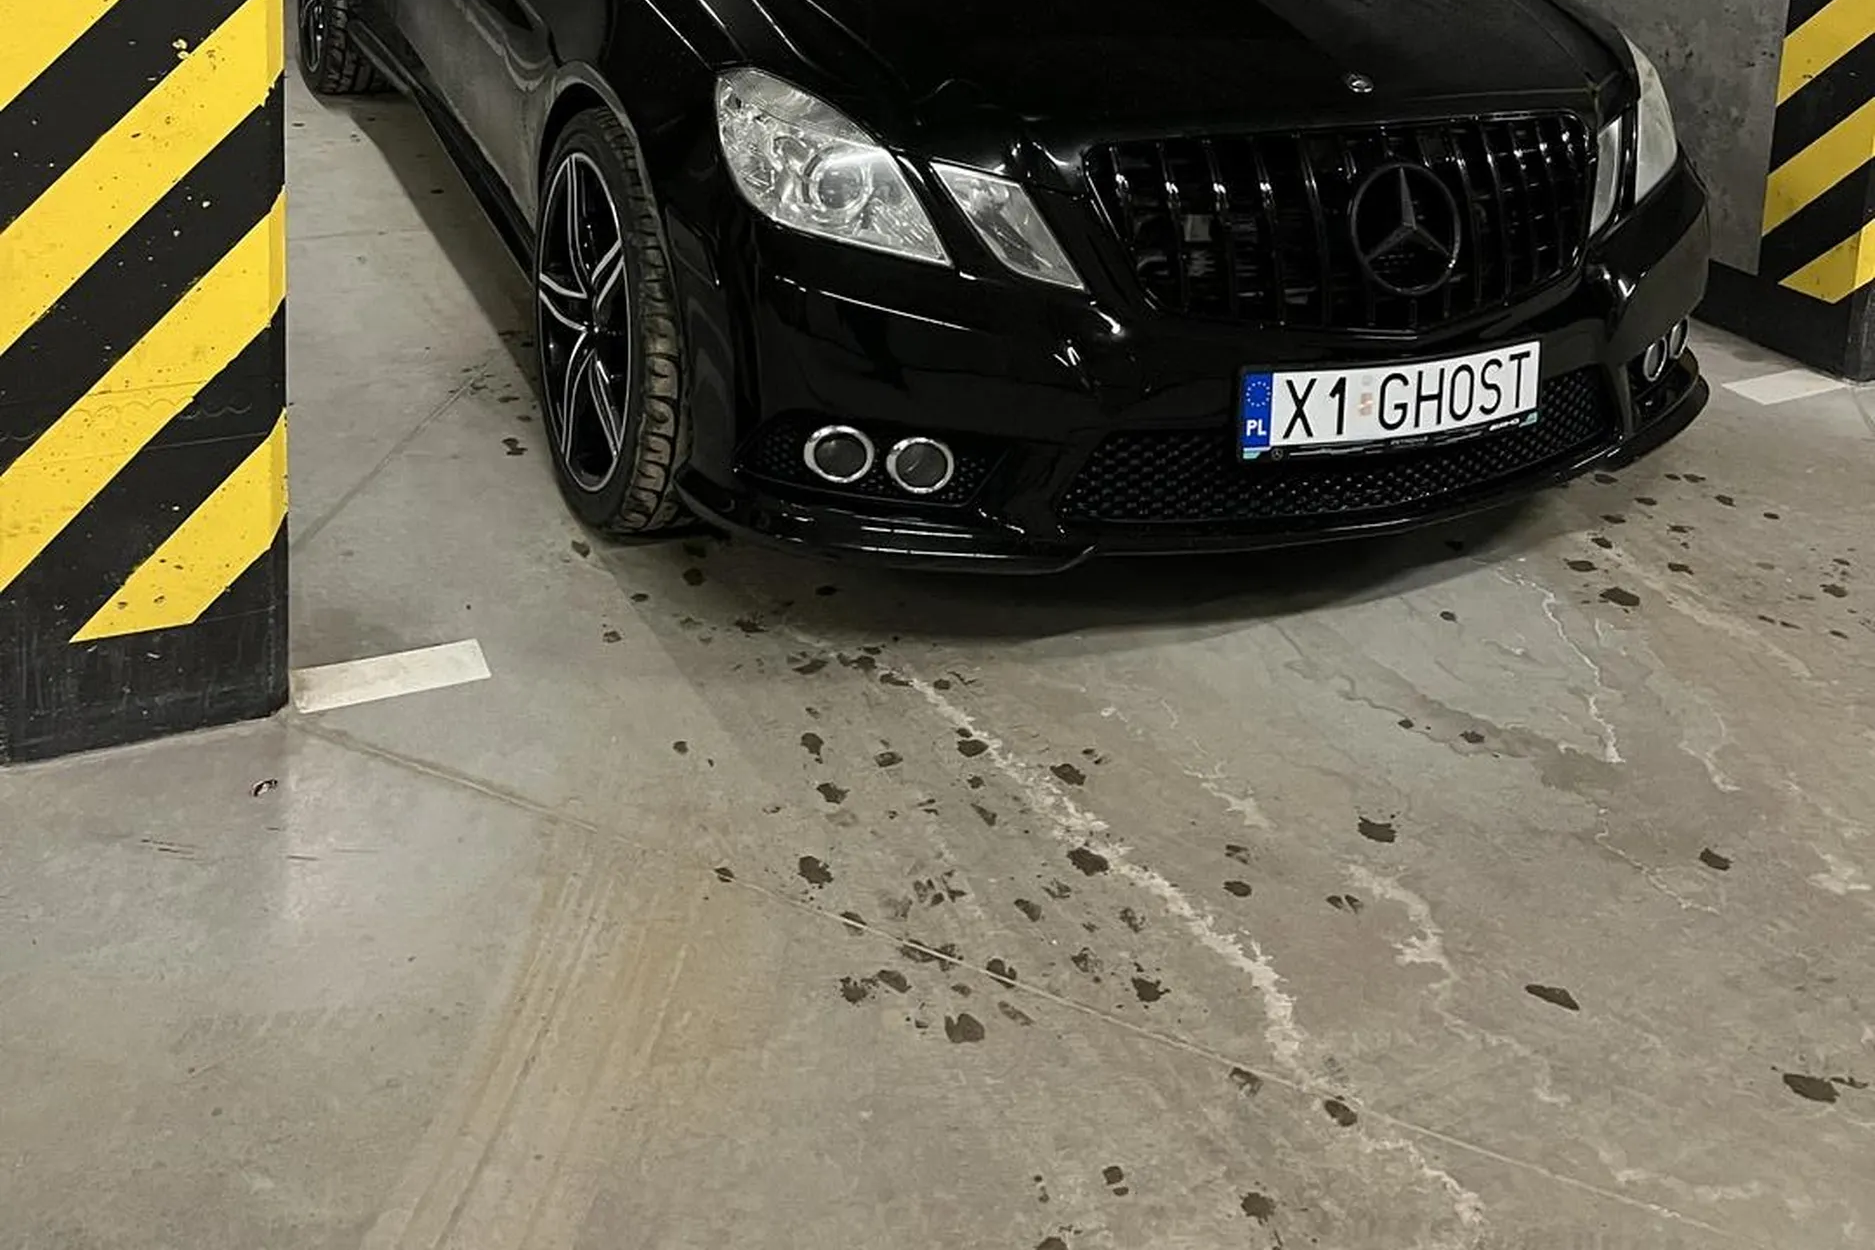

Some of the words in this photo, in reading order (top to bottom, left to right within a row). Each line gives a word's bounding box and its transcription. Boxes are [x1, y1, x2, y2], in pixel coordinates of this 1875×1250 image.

[1283, 377, 1347, 439] X1
[1378, 351, 1531, 430] GHOST
[1246, 420, 1266, 436] PL
